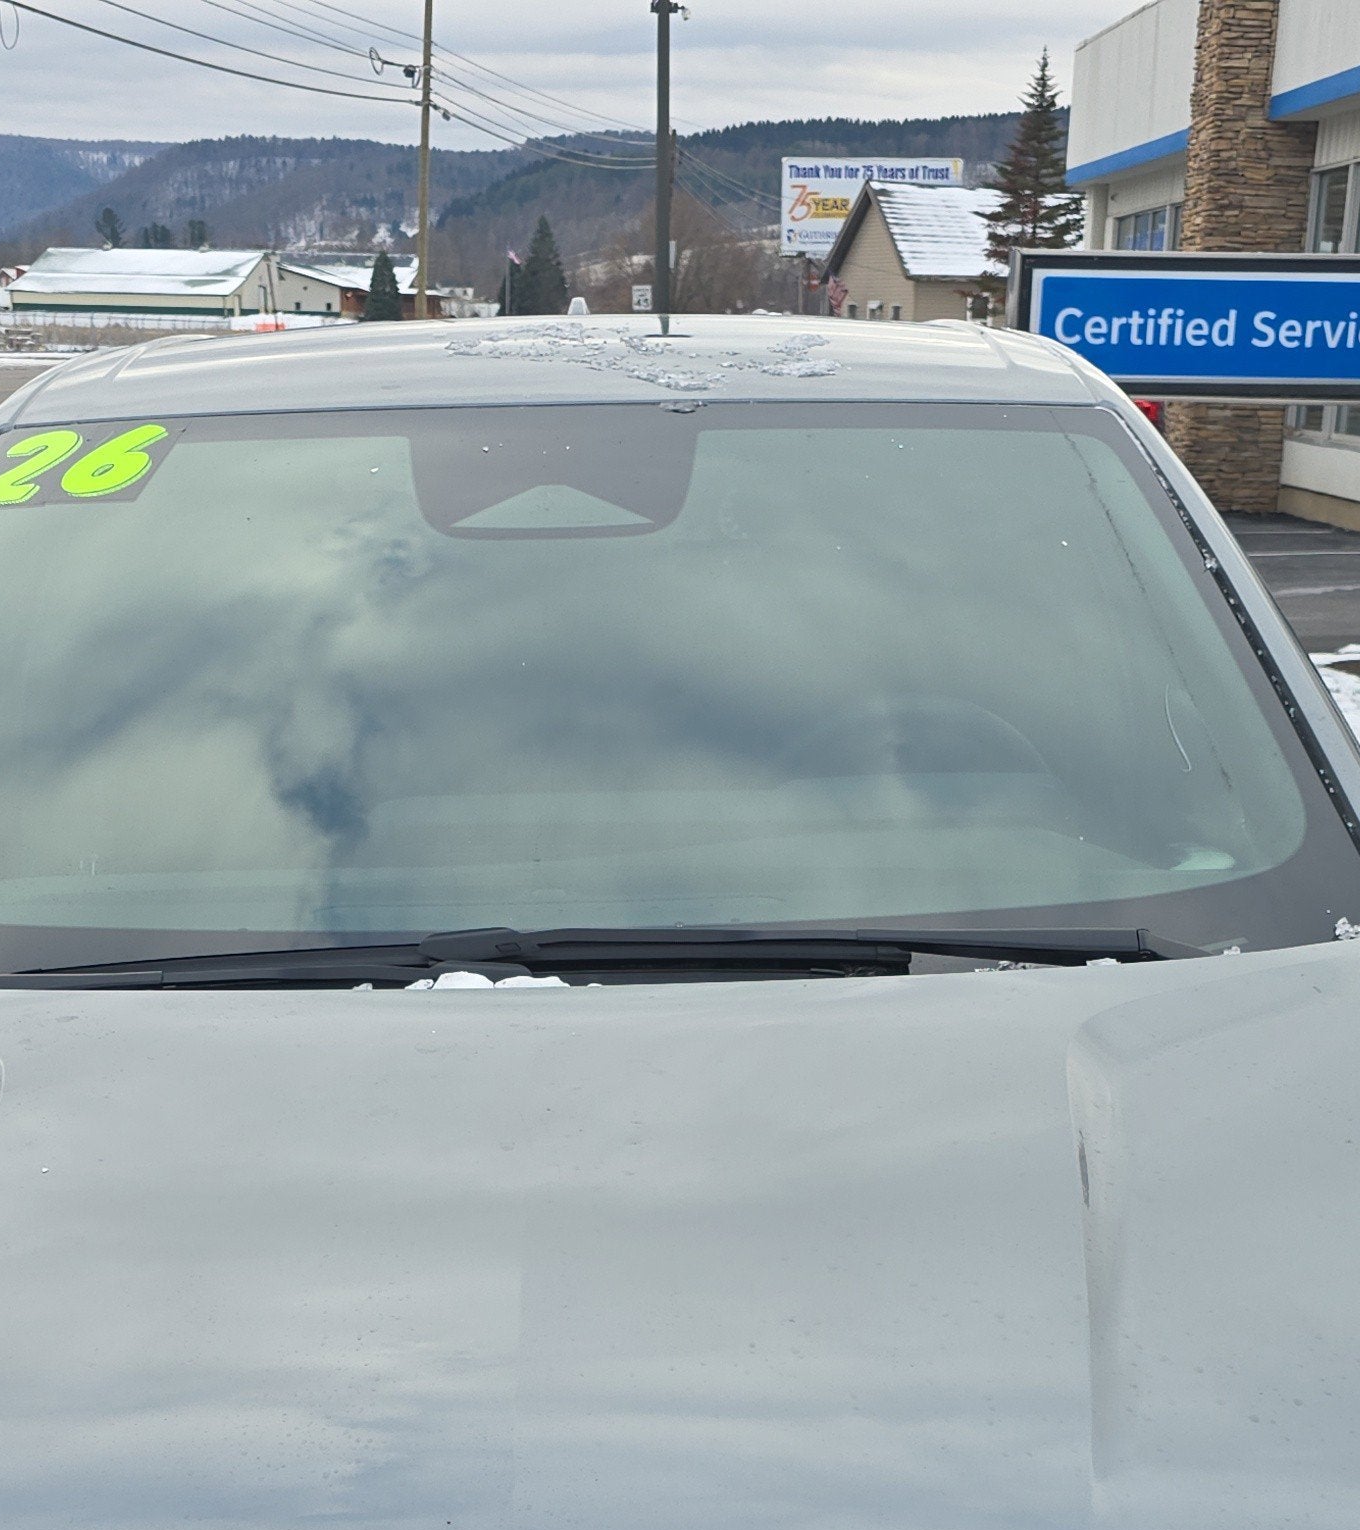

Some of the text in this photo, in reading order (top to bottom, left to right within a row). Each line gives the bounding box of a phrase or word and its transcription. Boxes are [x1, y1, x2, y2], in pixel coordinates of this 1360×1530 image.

[788, 164, 950, 180] Thank You for 75 Years of Trust
[788, 185, 850, 222] 75 YEAR
[1054, 307, 1237, 347] Certified
